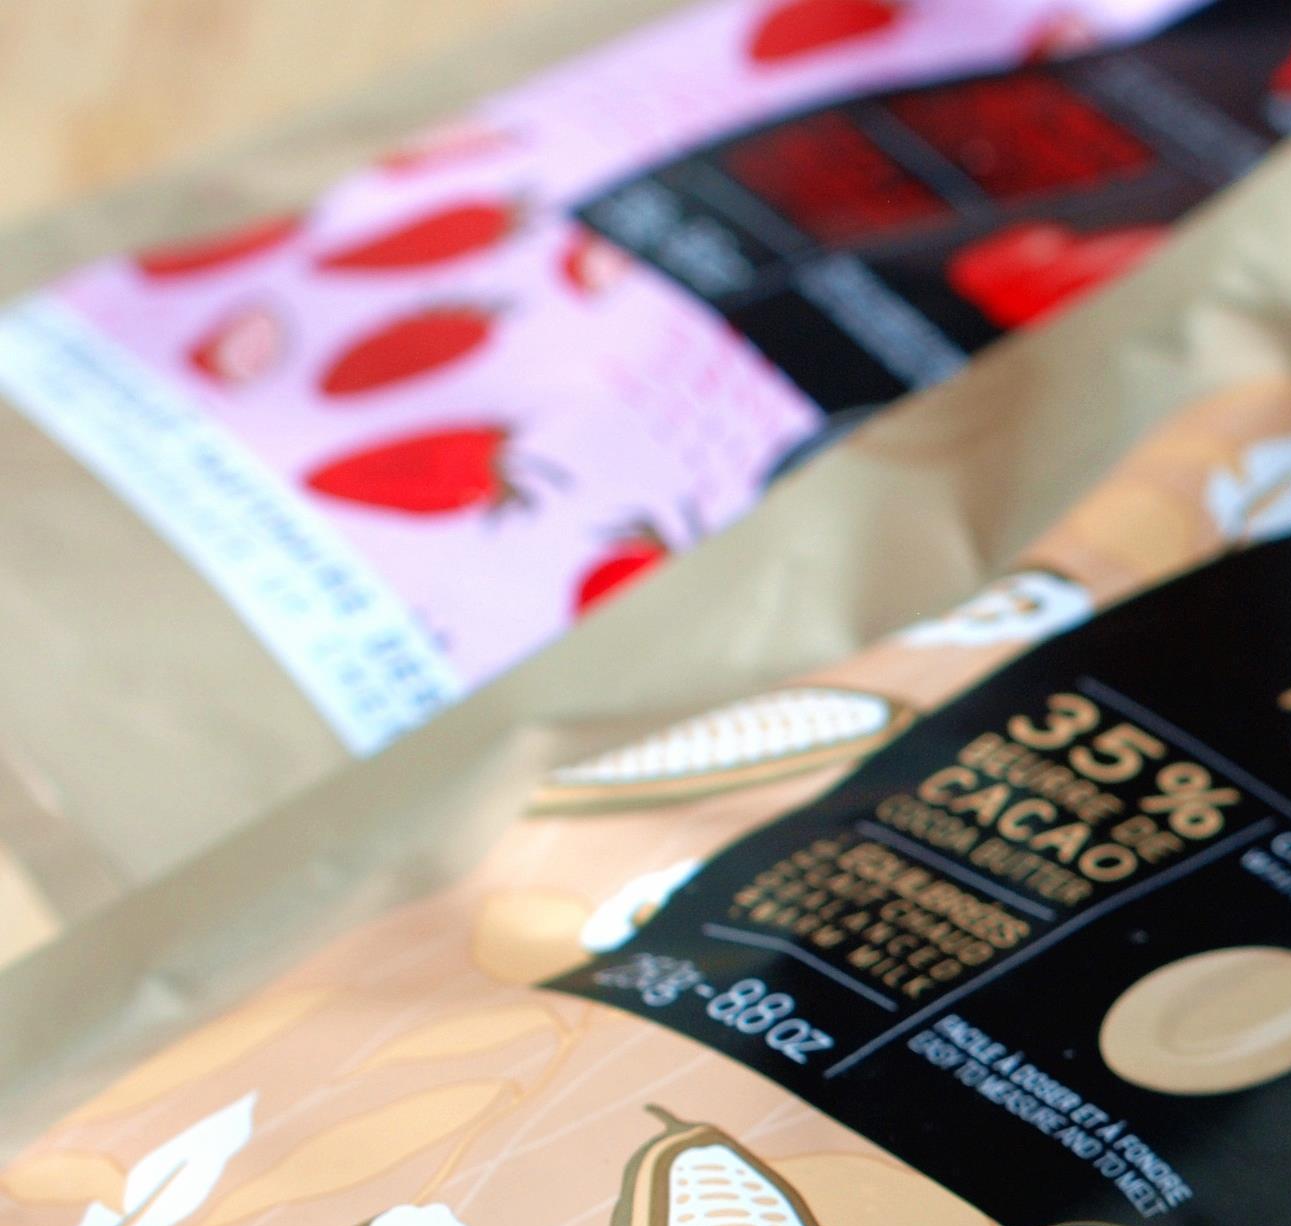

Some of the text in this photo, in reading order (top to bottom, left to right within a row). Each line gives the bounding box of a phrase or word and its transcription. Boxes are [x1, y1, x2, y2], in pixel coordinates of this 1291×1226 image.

[918, 766, 1137, 882] CACAO
[904, 1030, 1171, 1220] EASY TO MEASURE AND TO MELT
[1069, 1102, 1112, 1132] ET
[1113, 1134, 1195, 1207] FONDRE
